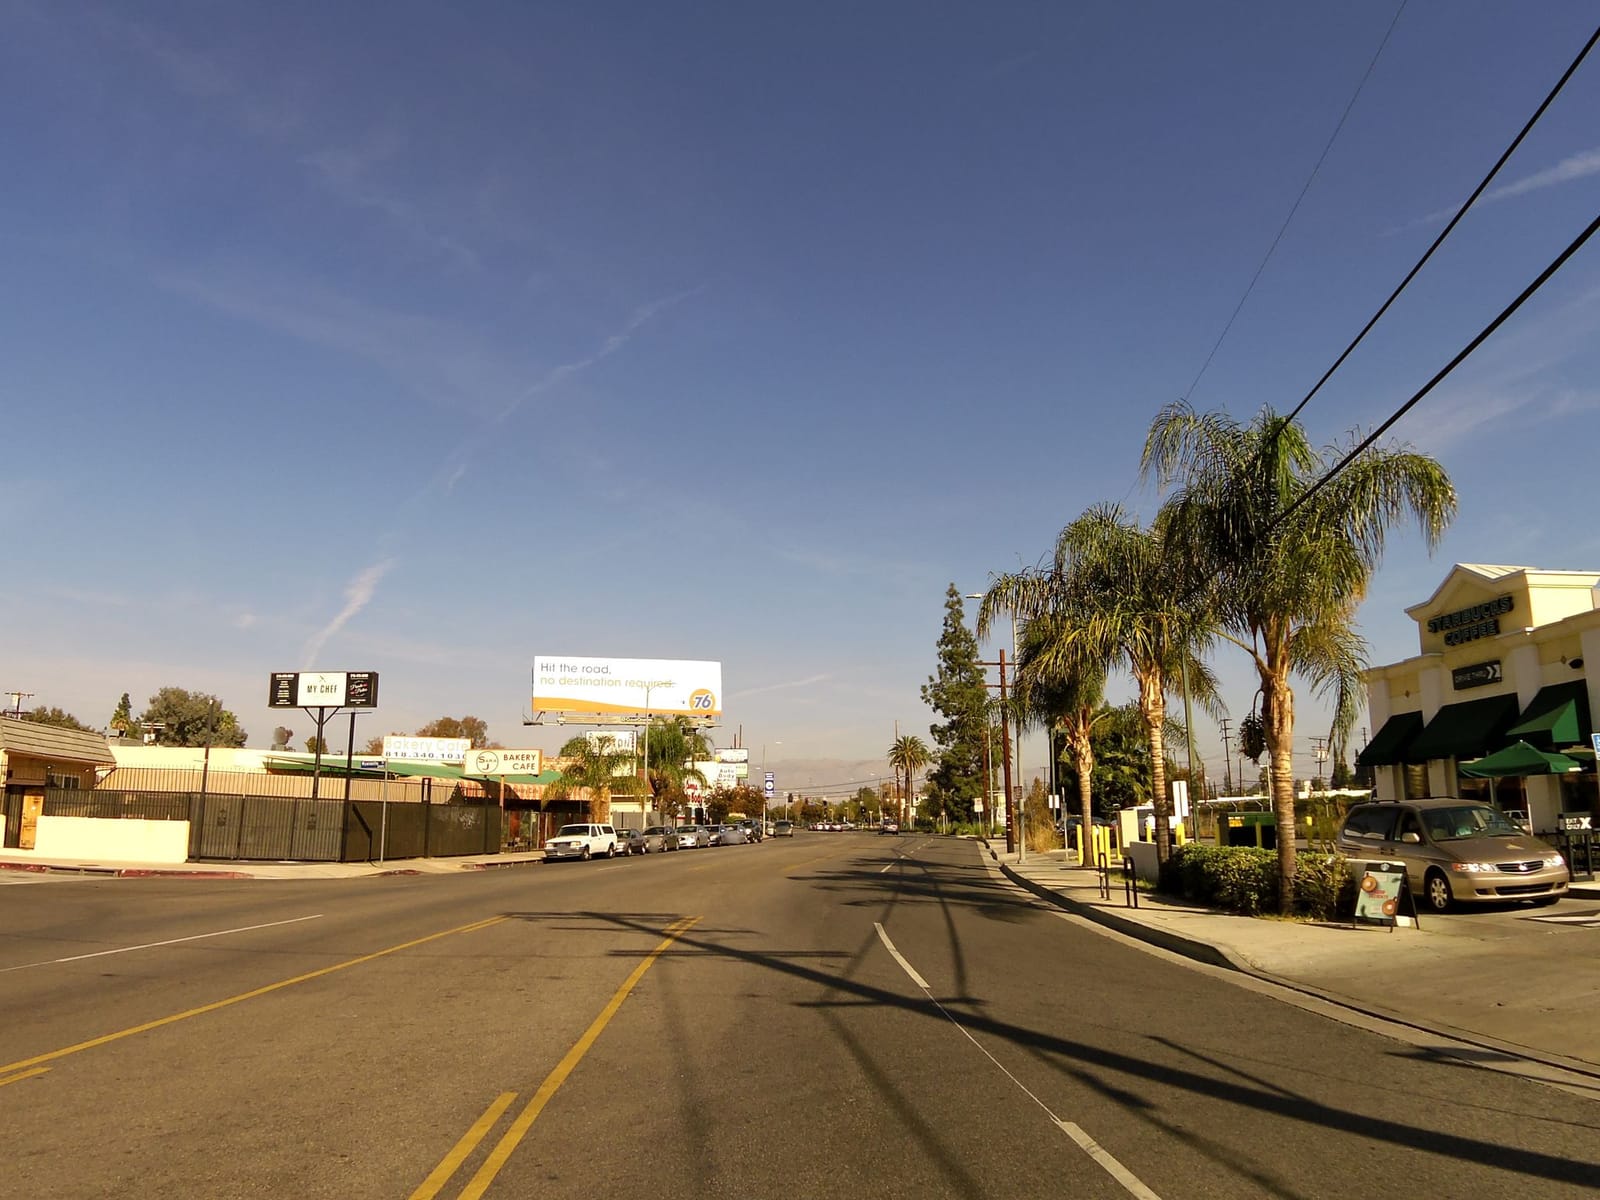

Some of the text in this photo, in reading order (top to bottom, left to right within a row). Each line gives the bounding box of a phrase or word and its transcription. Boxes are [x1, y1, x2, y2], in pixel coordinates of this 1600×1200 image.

[1428, 596, 1514, 633] STARBUCKS
[1445, 619, 1501, 646] COFFEE
[540, 662, 612, 676] Hit the road,
[540, 677, 555, 685] no
[558, 675, 621, 687] destination
[307, 684, 338, 693] MY CHEF
[693, 695, 712, 709] 76
[503, 753, 536, 761] BAKERY
[512, 762, 536, 770] CAFE
